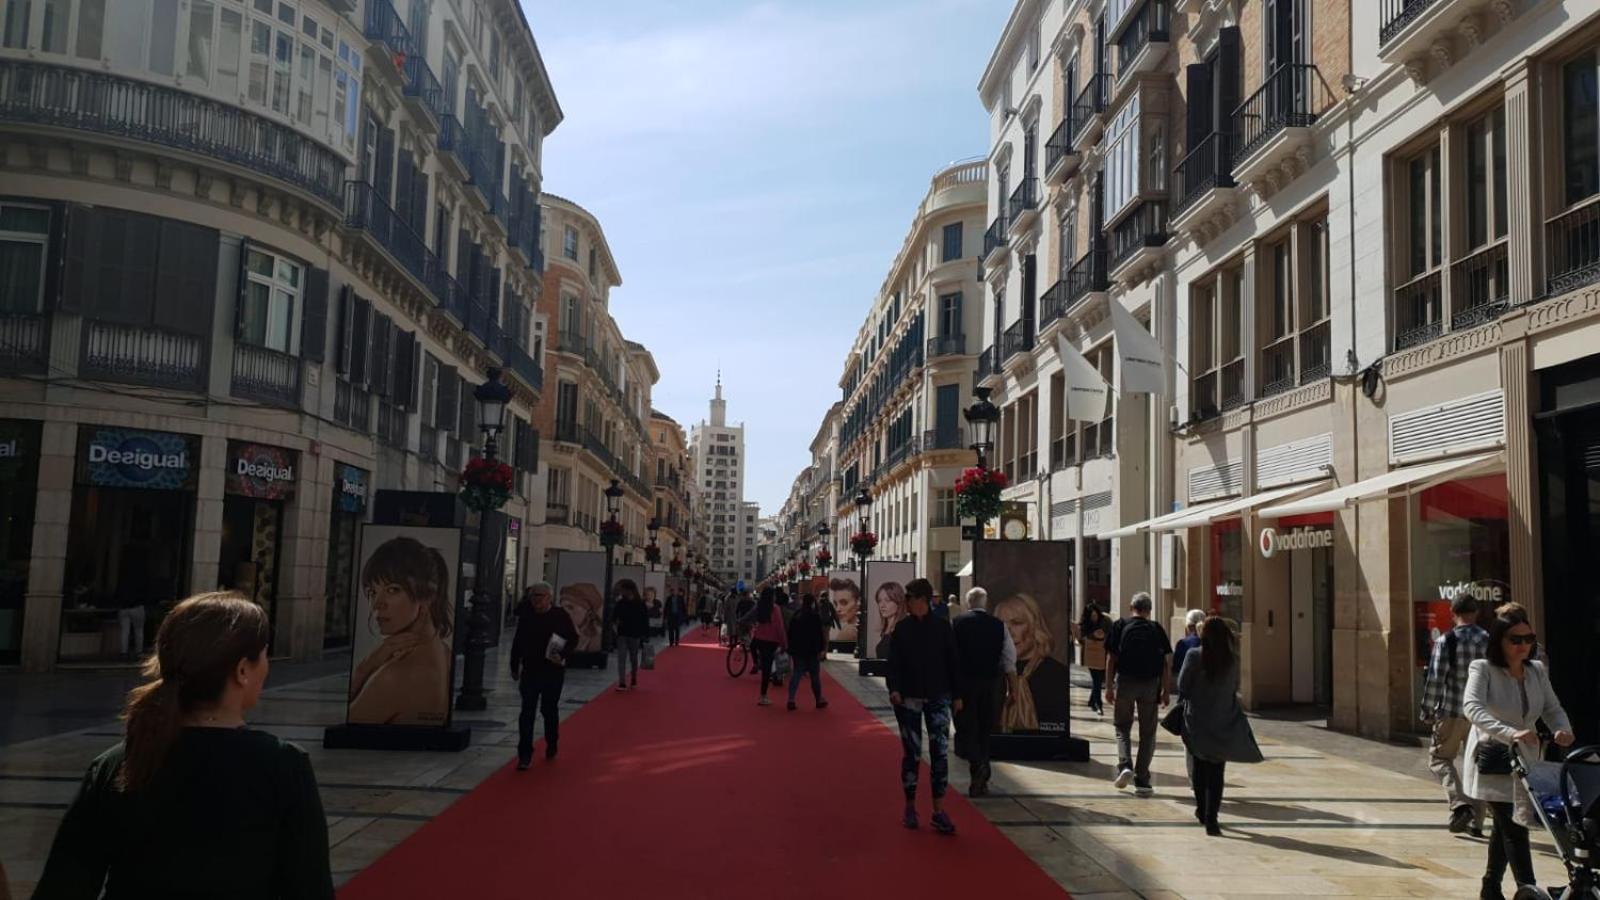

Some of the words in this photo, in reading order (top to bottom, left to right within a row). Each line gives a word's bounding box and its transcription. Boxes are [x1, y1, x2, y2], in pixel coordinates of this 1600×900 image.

[89, 445, 185, 470] Desigual
[238, 459, 292, 482] Desigual
[1276, 526, 1333, 551] vodafone
